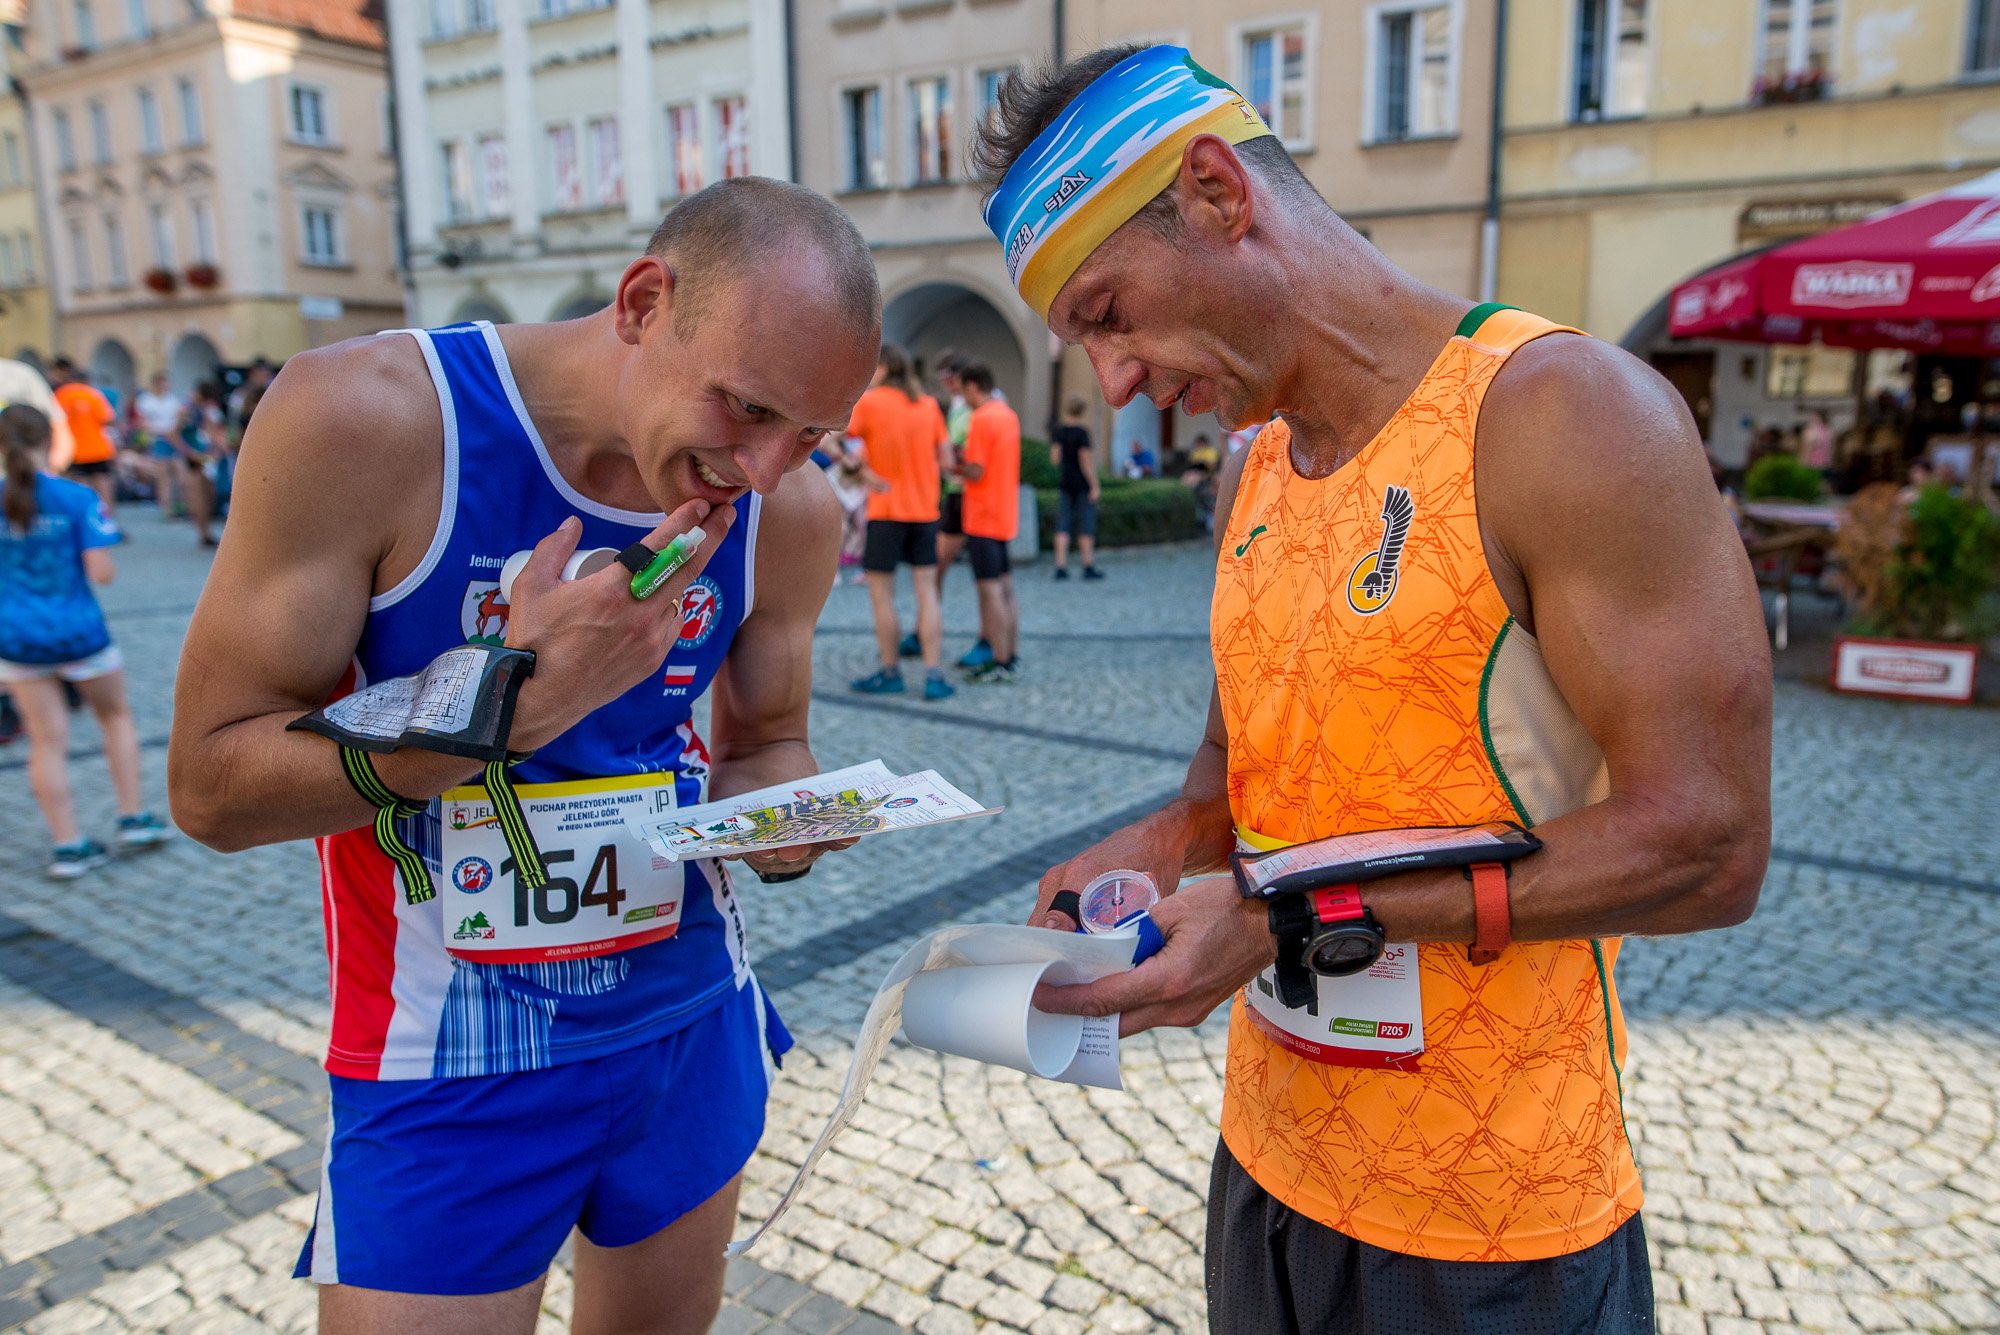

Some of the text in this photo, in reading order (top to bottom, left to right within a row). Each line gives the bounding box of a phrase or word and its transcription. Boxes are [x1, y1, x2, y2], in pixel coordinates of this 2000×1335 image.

[469, 554, 507, 569] Jeleni
[663, 688, 687, 696] POL
[530, 794, 643, 813] PUCHAR PREZYDENTA MIASTA
[562, 807, 620, 822] JELENIEJ GÓRY
[565, 823, 583, 831] BIEGU
[500, 844, 626, 927] 164
[544, 947, 571, 957] JELENIA
[572, 944, 589, 954] GÓRA
[1381, 1025, 1403, 1036] PZOS
